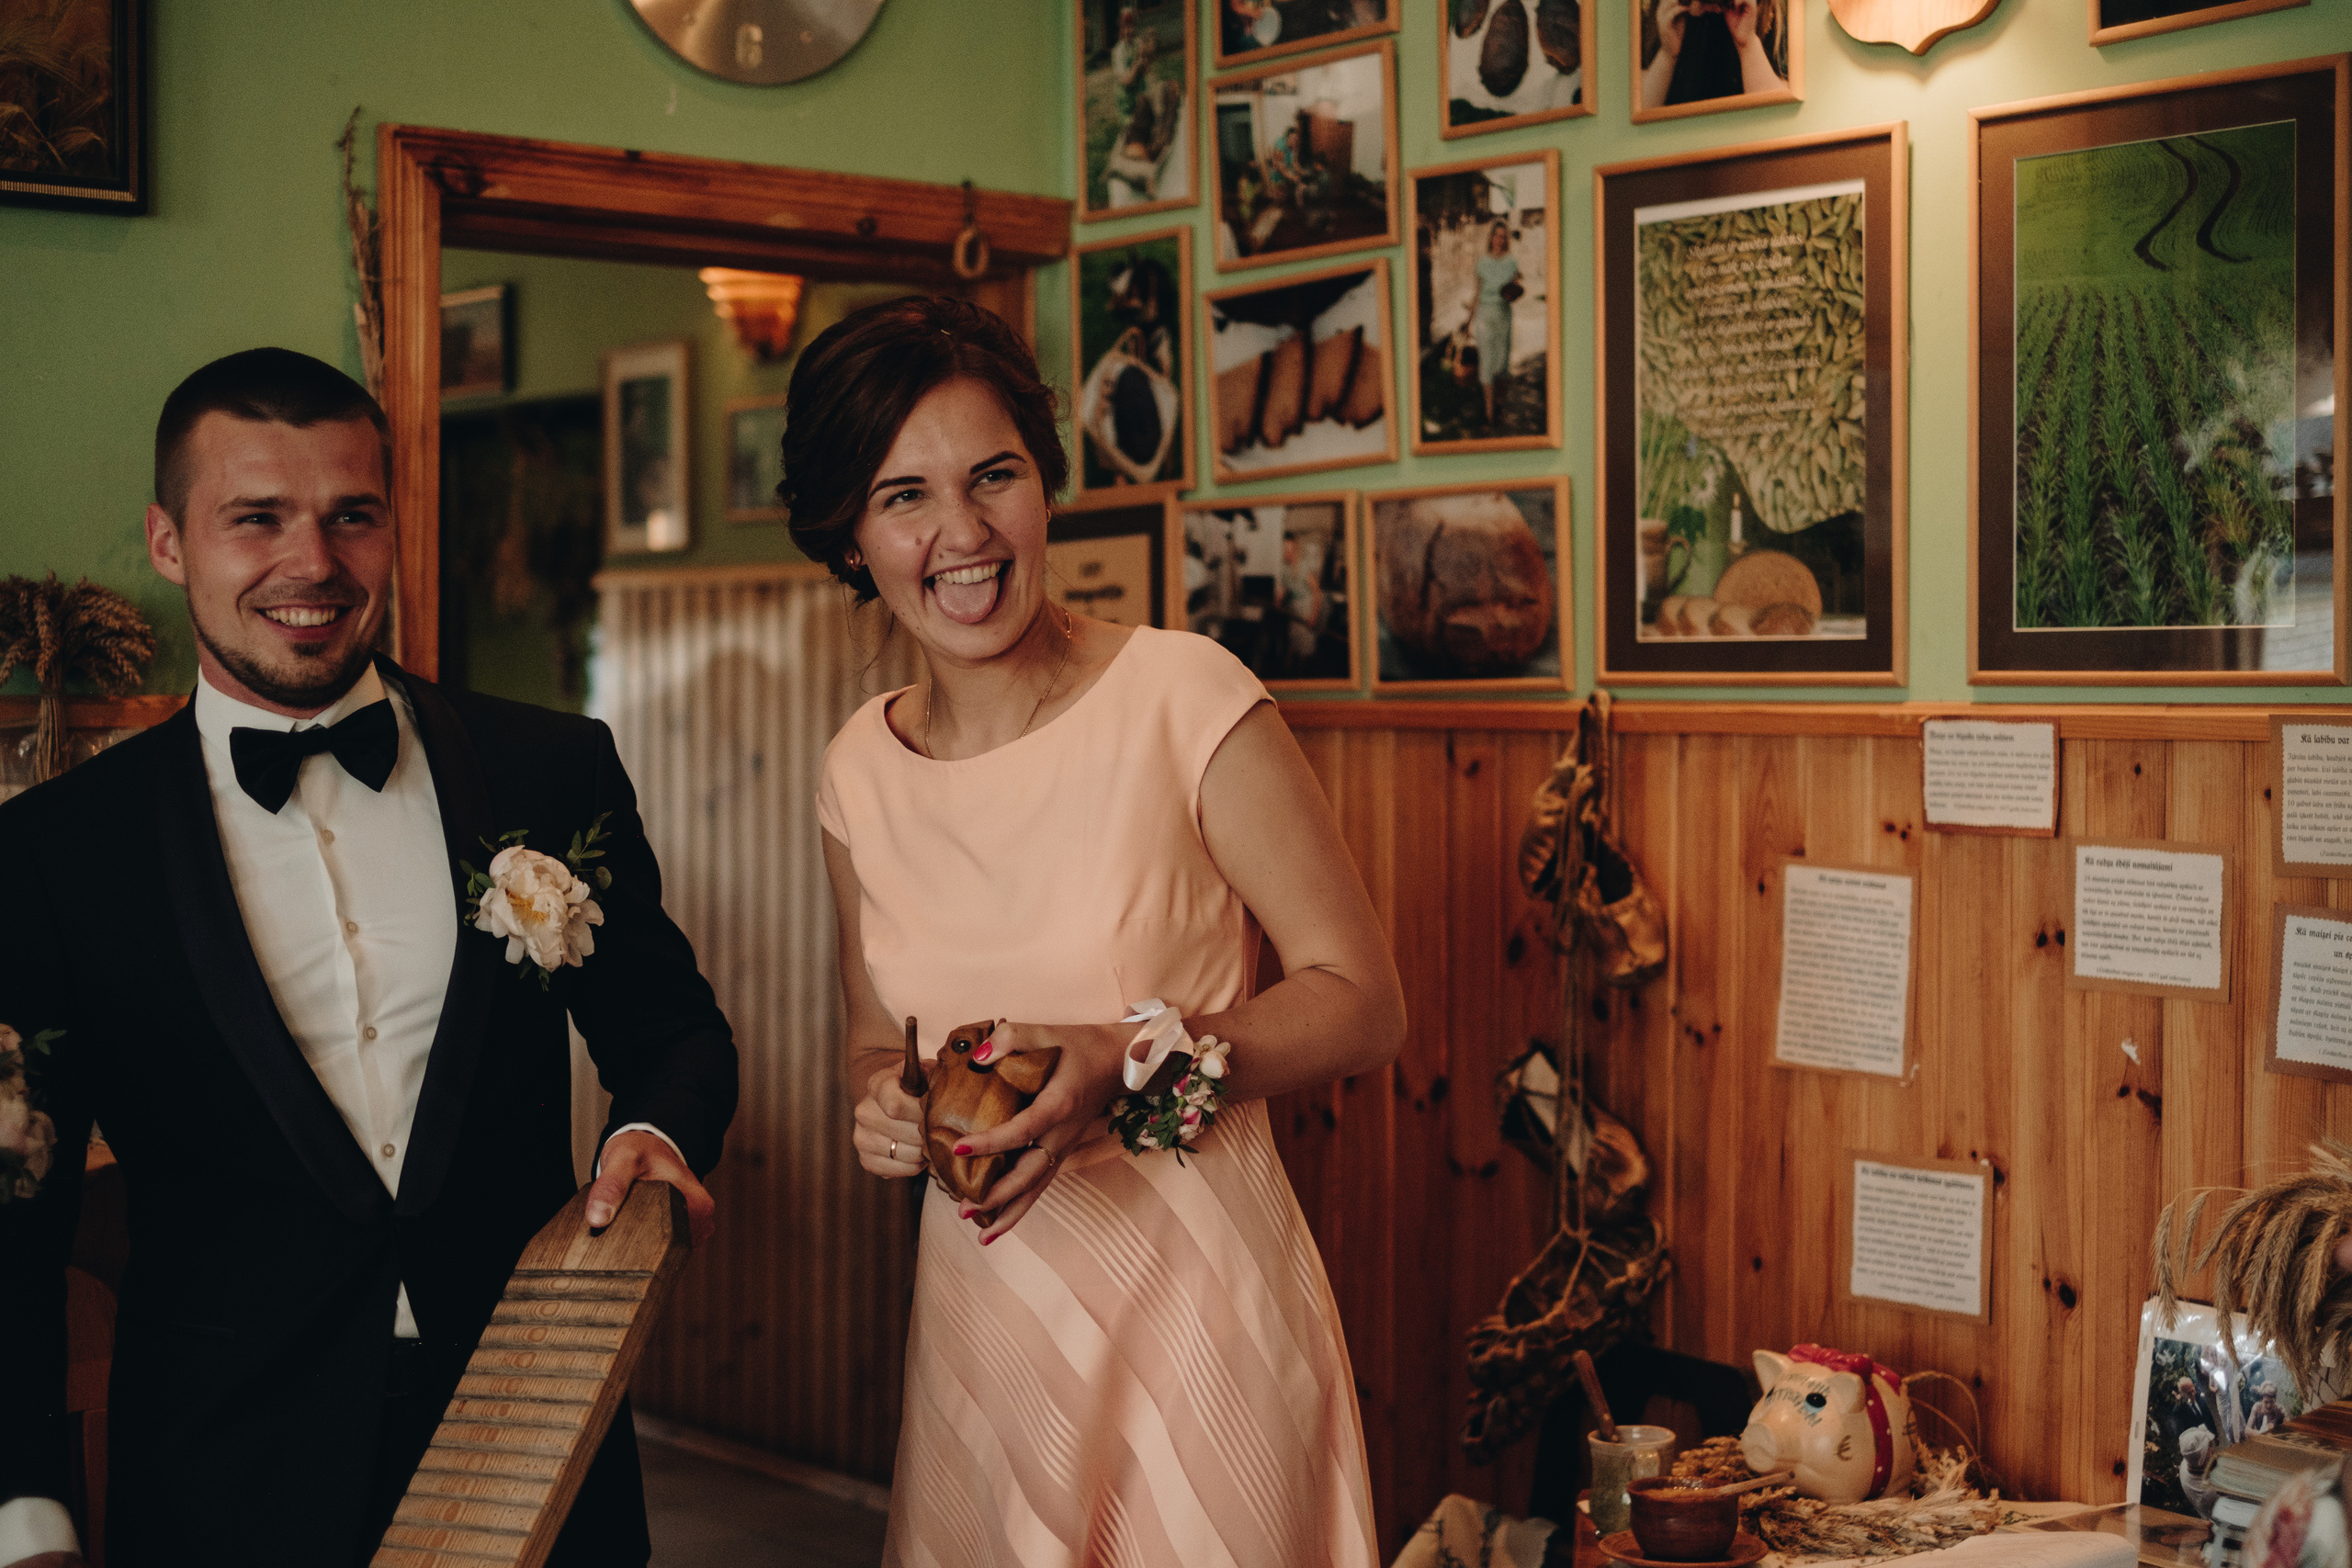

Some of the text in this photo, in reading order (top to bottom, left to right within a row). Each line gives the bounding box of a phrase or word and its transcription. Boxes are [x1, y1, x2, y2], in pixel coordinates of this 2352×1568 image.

[735, 22, 763, 69] 6
[2337, 737, 2350, 745] var
[2334, 932, 2344, 942] pie
